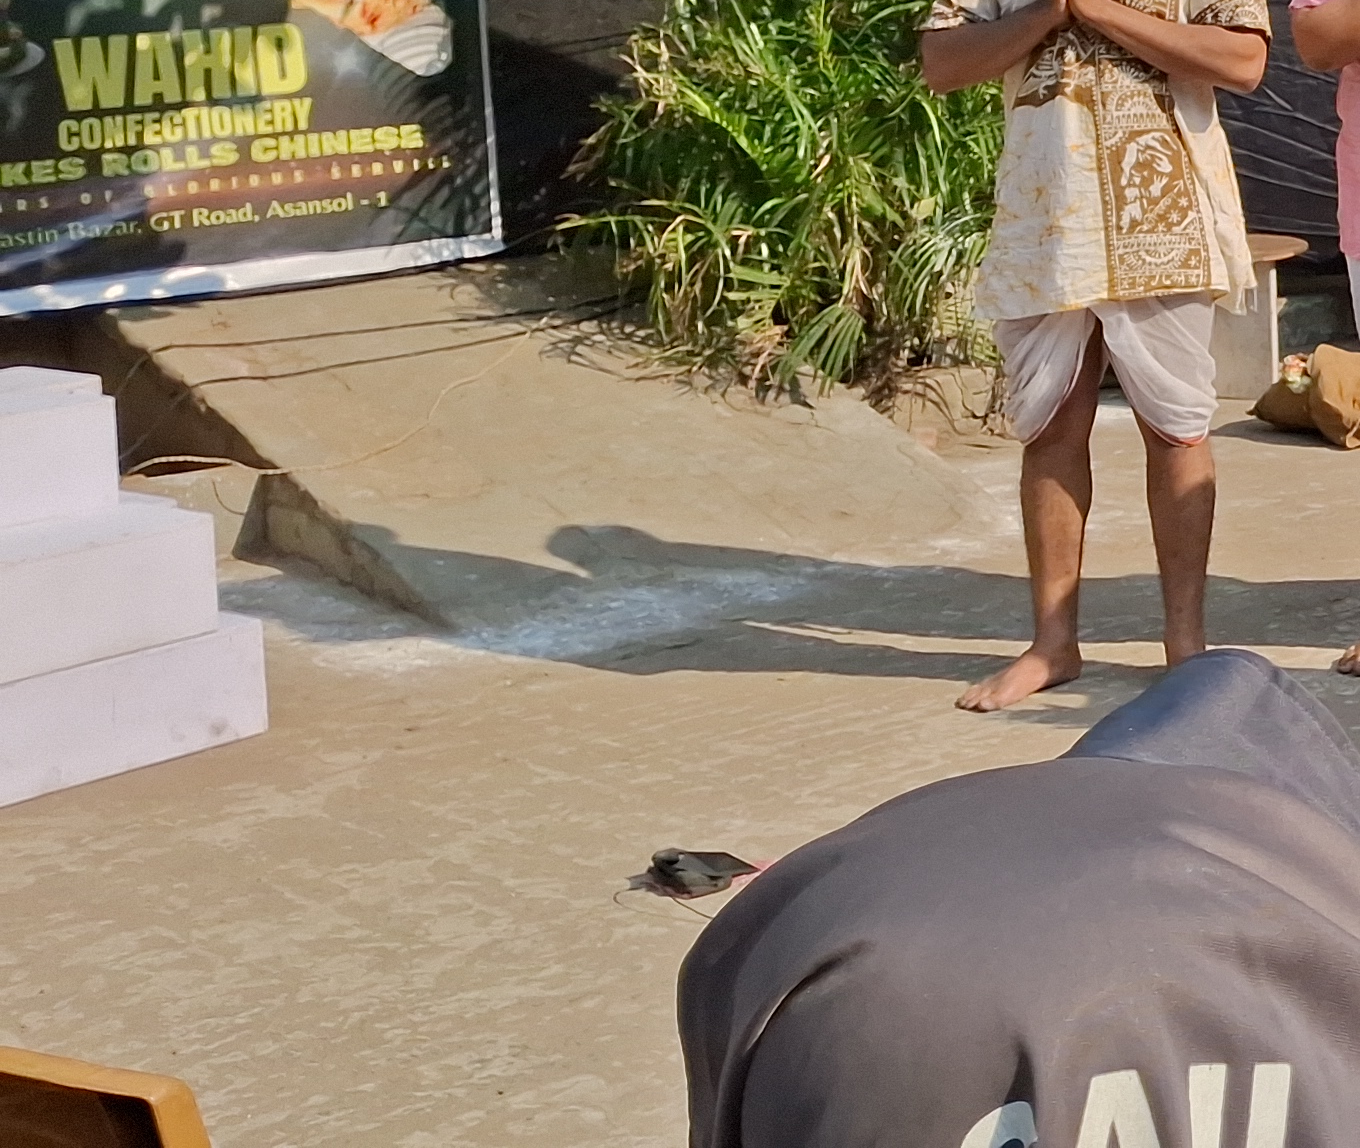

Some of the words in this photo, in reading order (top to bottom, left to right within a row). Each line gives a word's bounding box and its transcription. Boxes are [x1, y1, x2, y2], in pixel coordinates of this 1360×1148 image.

[53, 23, 307, 112] WAHID
[58, 98, 312, 152] CONFECTIONERY
[102, 141, 240, 179] ROLLS
[250, 123, 424, 165] CHINESE
[149, 210, 184, 232] GT
[192, 202, 260, 229] Road,
[266, 193, 354, 219] Asansol
[376, 190, 391, 208] 1
